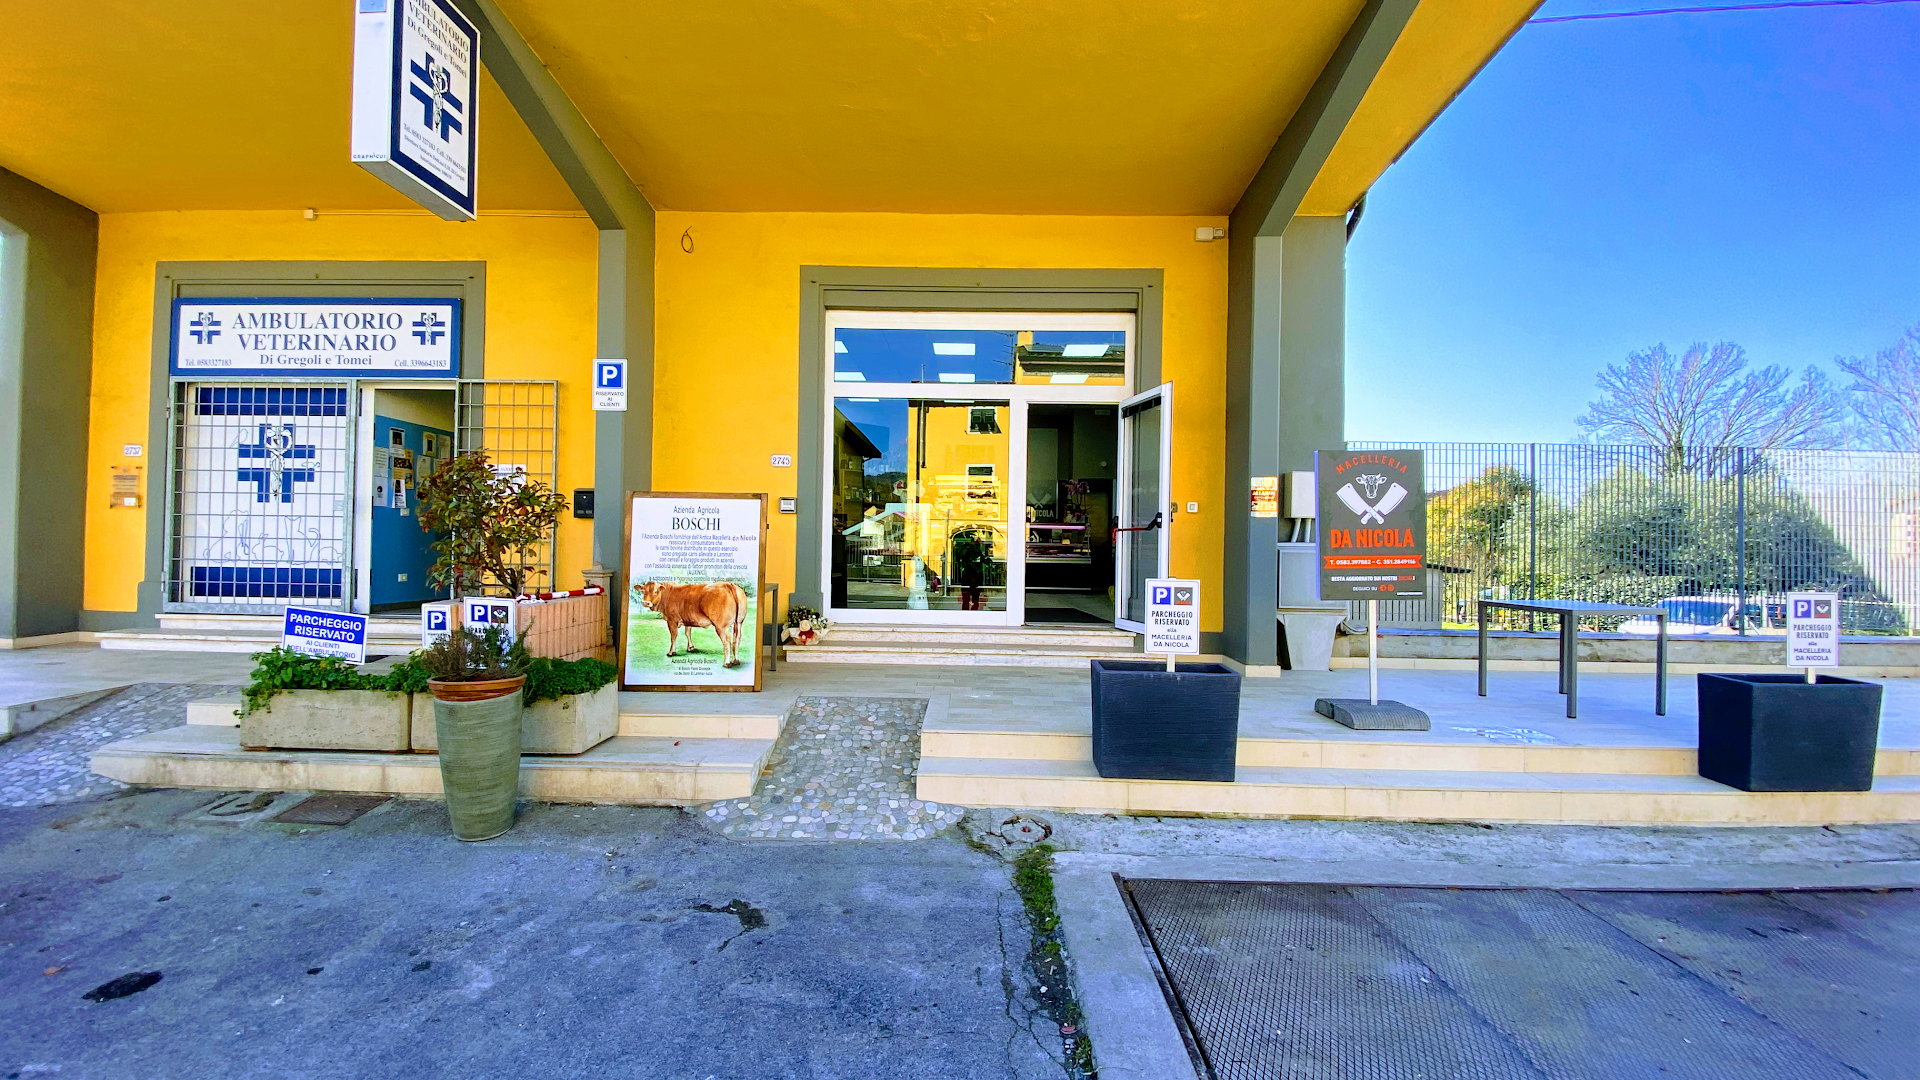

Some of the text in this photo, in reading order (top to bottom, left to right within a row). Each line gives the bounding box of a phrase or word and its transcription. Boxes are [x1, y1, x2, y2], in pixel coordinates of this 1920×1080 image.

[409, 1, 467, 63] VETERINARIO
[408, 16, 416, 31] Di
[418, 26, 443, 56] Gregoli
[449, 54, 467, 79] Tomei
[232, 312, 403, 330] AMBULATORIO
[238, 333, 397, 351] VETERINARIO
[185, 359, 196, 367] Tel.
[260, 354, 372, 367] Di Gregoli e Tomei
[394, 359, 447, 368] Cell. 3396643183
[603, 366, 618, 386] P
[772, 457, 790, 465] 2745
[1336, 455, 1408, 475] MACELLERIA
[674, 506, 720, 515] Azienda Agricola
[672, 518, 721, 531] BOSCHI
[1331, 529, 1415, 548] DA NICOLA
[1156, 588, 1168, 604] P
[474, 606, 486, 621] P
[1797, 602, 1809, 617] P
[290, 614, 362, 631] PARCHEGGIO
[430, 612, 444, 629] P
[294, 625, 355, 642] RISERVATO
[314, 641, 340, 650] CLIENTI
